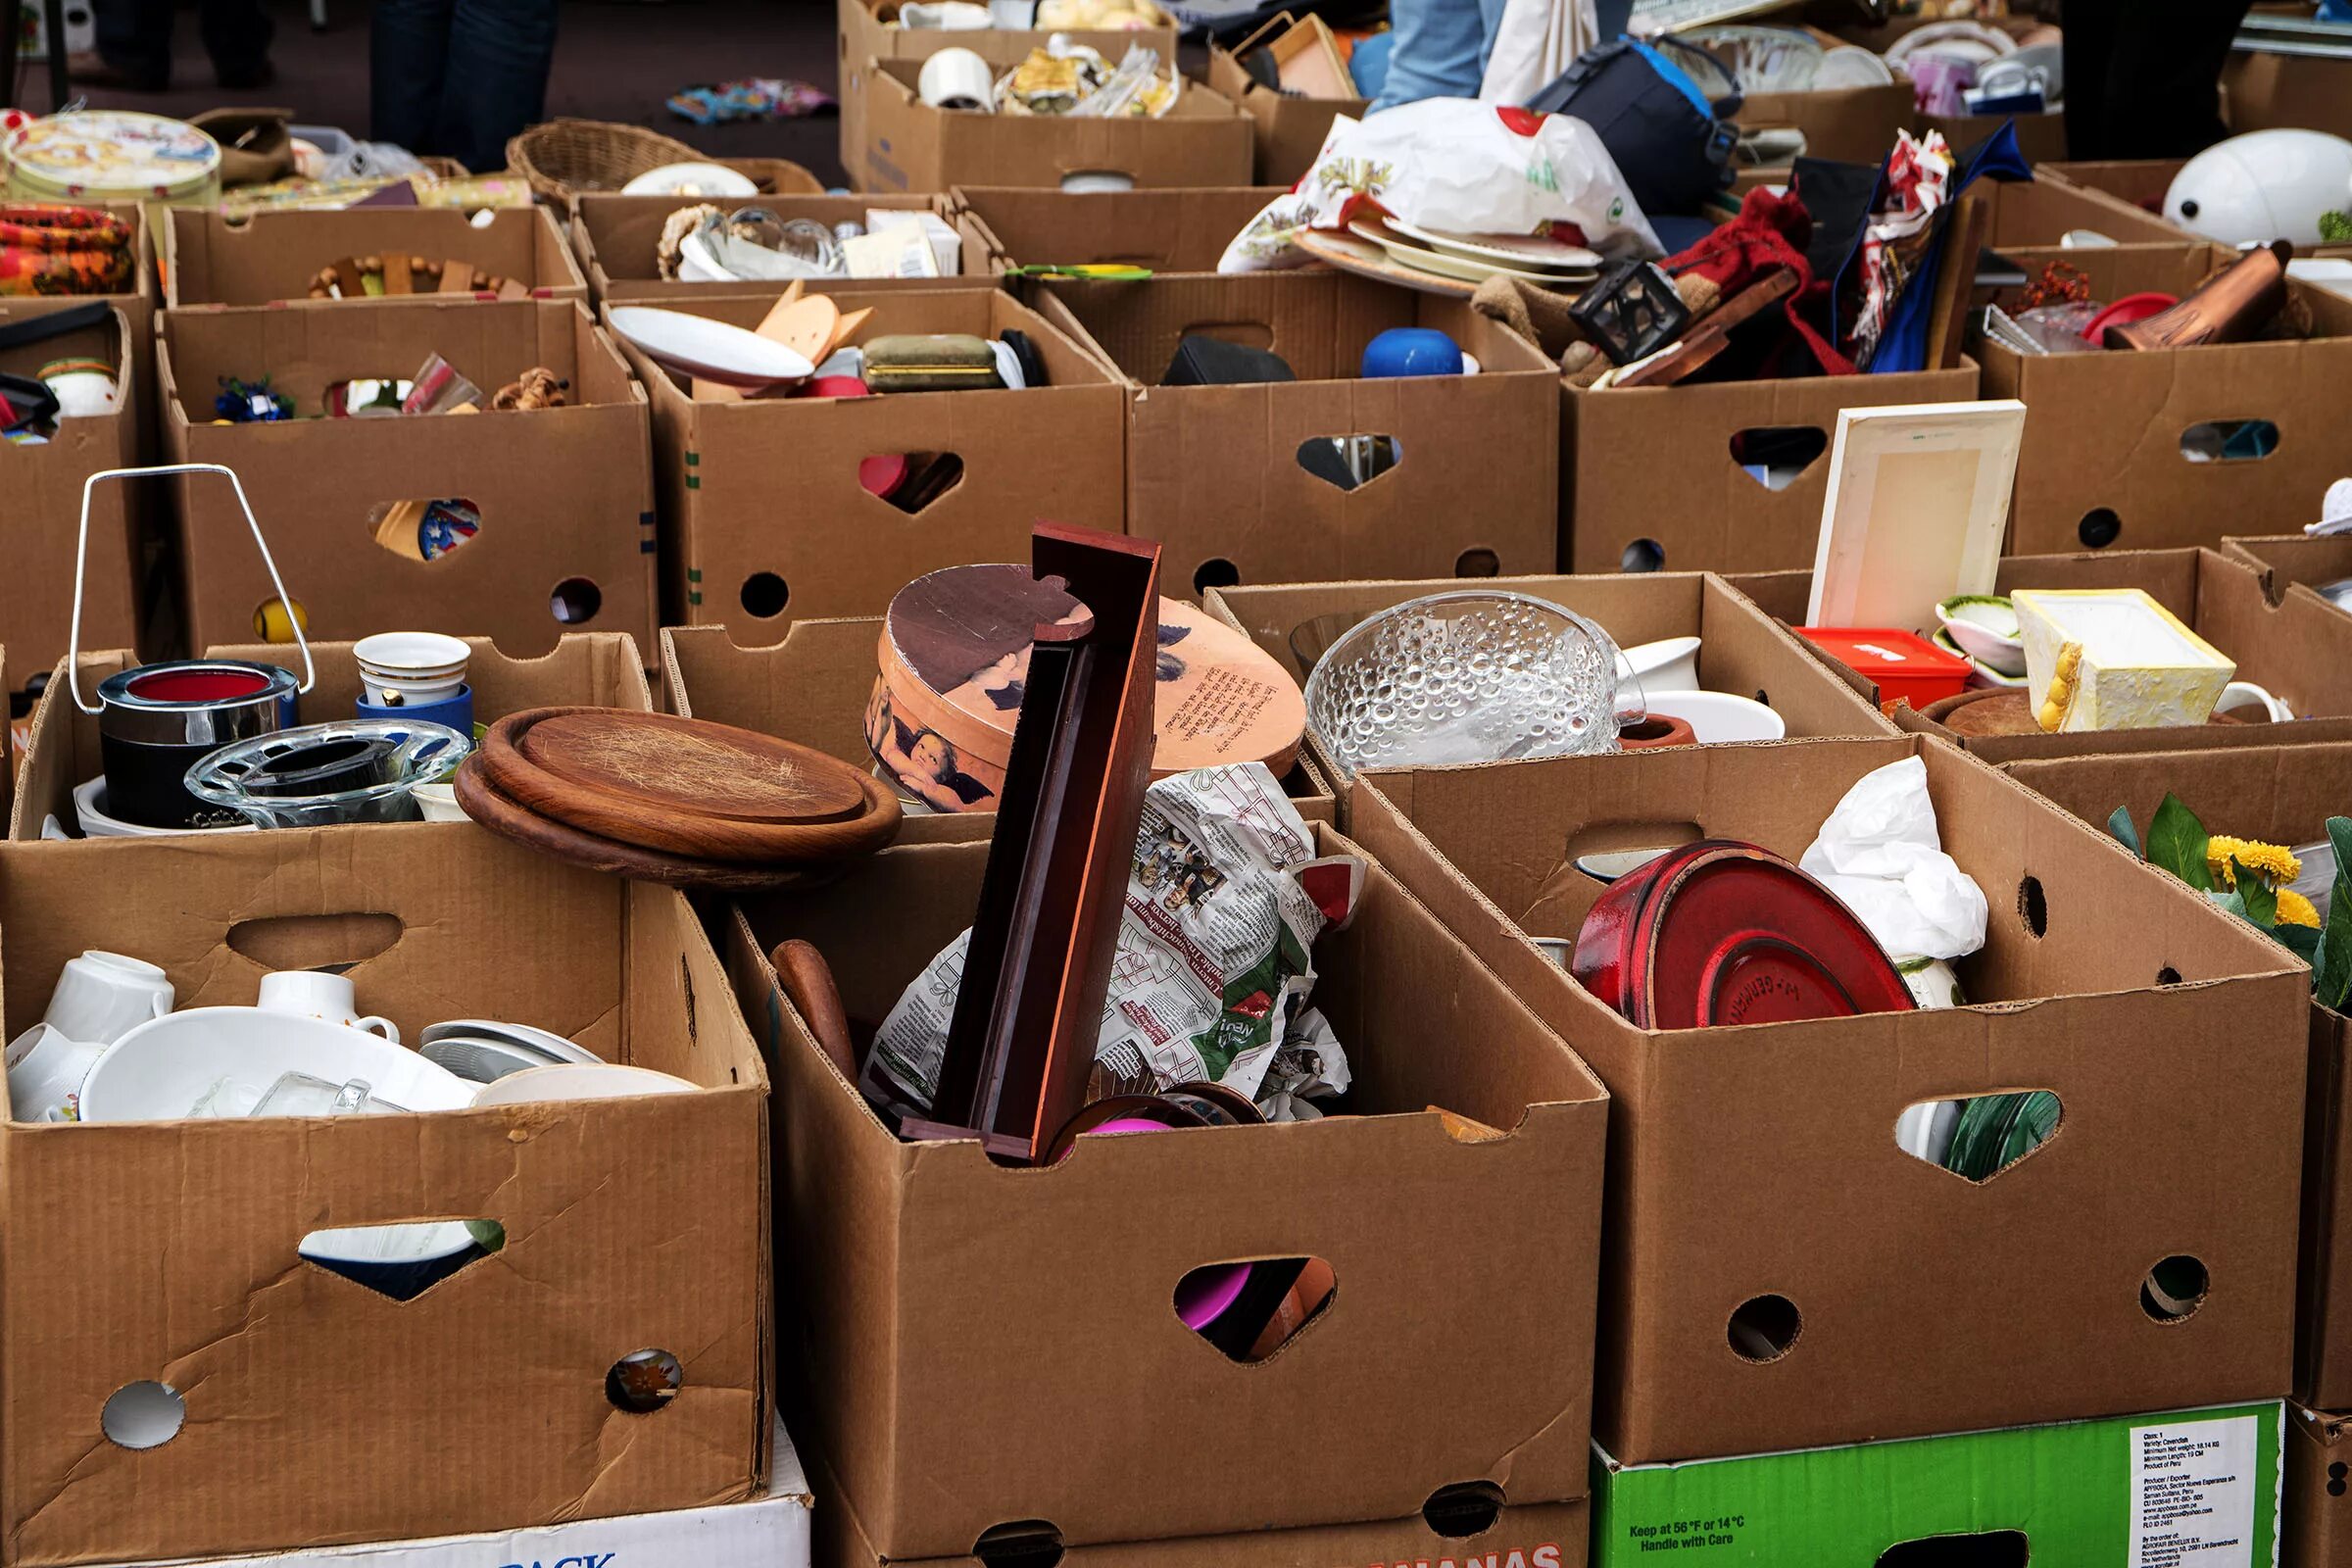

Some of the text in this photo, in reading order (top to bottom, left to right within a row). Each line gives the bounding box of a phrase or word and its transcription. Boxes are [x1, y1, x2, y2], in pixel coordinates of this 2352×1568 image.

[1630, 1526, 1657, 1538] Keep
[1660, 1523, 1672, 1535] at
[1674, 1522, 1688, 1534] 56
[1703, 1521, 1716, 1530] or
[1717, 1517, 1731, 1529] 14
[1641, 1534, 1734, 1551] Handle with Care
